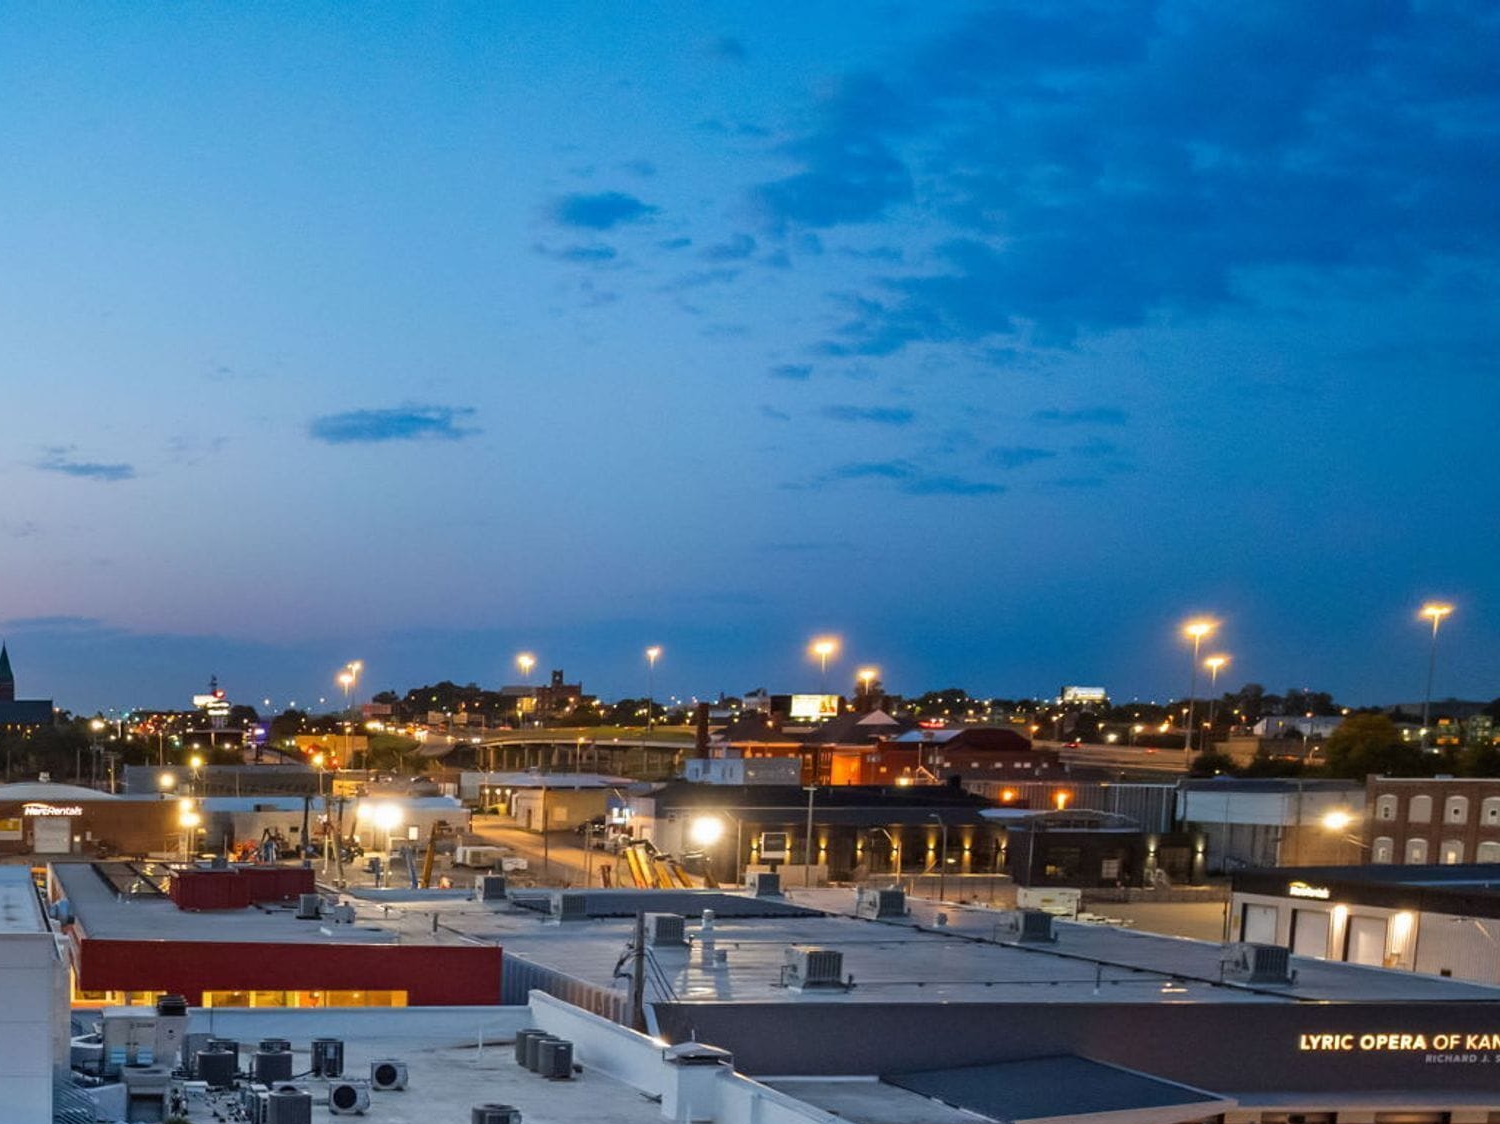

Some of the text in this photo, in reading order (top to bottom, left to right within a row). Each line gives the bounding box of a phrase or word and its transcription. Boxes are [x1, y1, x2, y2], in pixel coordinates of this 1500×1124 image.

[1300, 1034, 1354, 1050] LYRIC
[1359, 1034, 1427, 1050] OPERA
[1433, 1034, 1462, 1050] OF
[1425, 1054, 1477, 1063] RICHARD
[1480, 1054, 1490, 1063] J.
